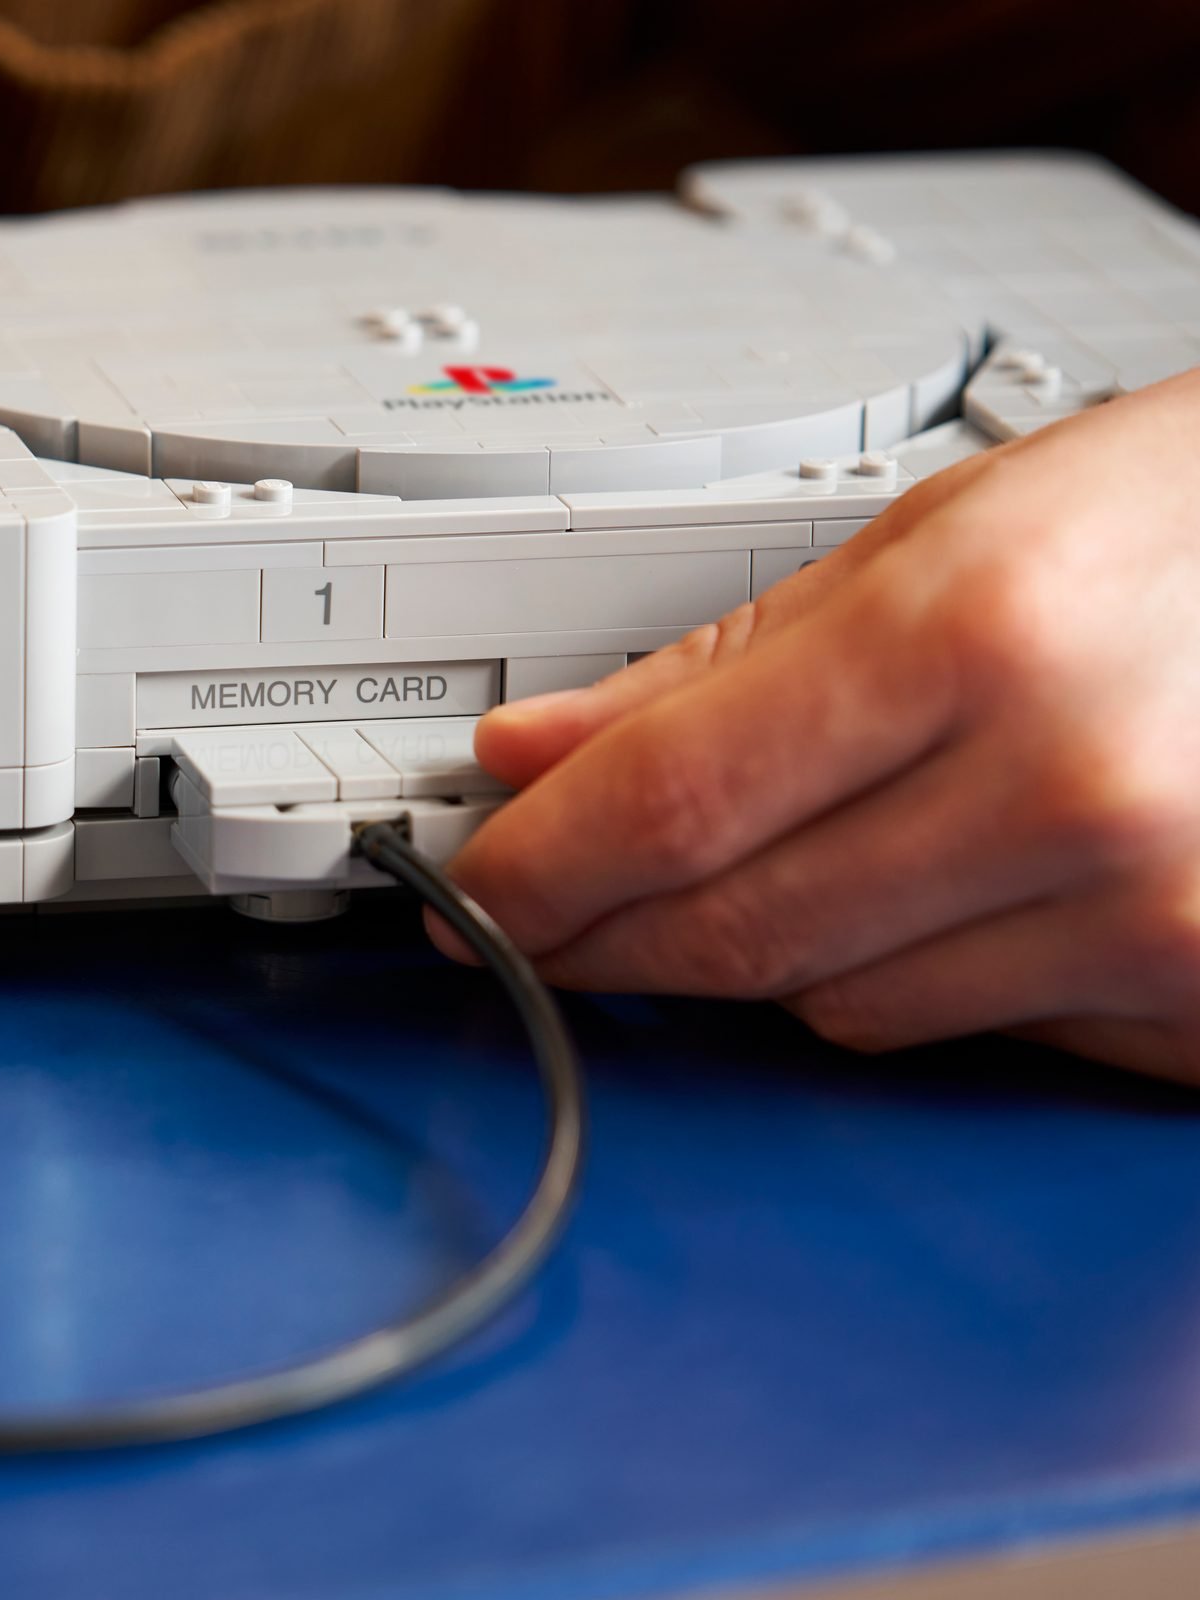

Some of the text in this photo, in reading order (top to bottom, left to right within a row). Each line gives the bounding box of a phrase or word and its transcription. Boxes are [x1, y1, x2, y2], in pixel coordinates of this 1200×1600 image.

[382, 393, 612, 411] PlayStation
[314, 582, 332, 625] 1
[191, 675, 448, 709] MEMORY CARD
